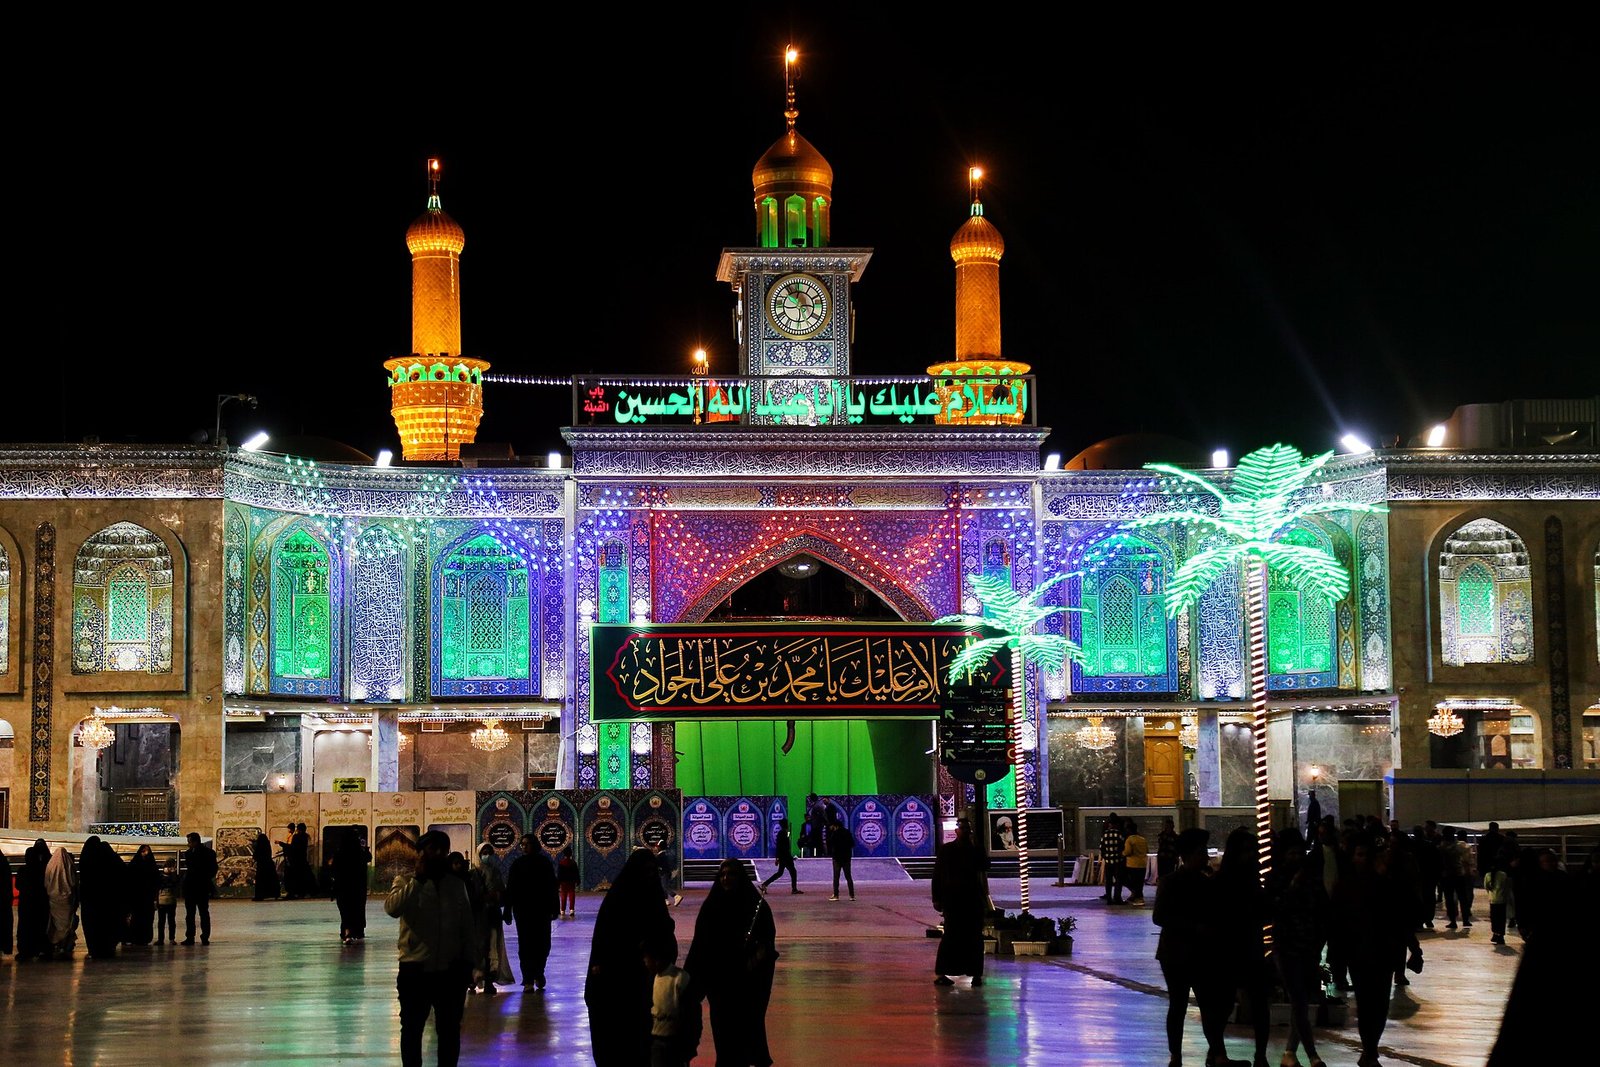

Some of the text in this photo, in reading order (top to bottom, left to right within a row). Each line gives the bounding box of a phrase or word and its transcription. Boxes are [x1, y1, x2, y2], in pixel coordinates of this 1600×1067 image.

[583, 399, 610, 417] القبلة
[588, 386, 605, 399] باب
[615, 385, 704, 424] الحسين
[708, 388, 751, 415] الله
[756, 389, 813, 424] عبد
[845, 385, 866, 424] يا
[870, 385, 942, 424] عليك
[948, 383, 1028, 421] السلام
[967, 704, 1004, 716] شارع الشهداء
